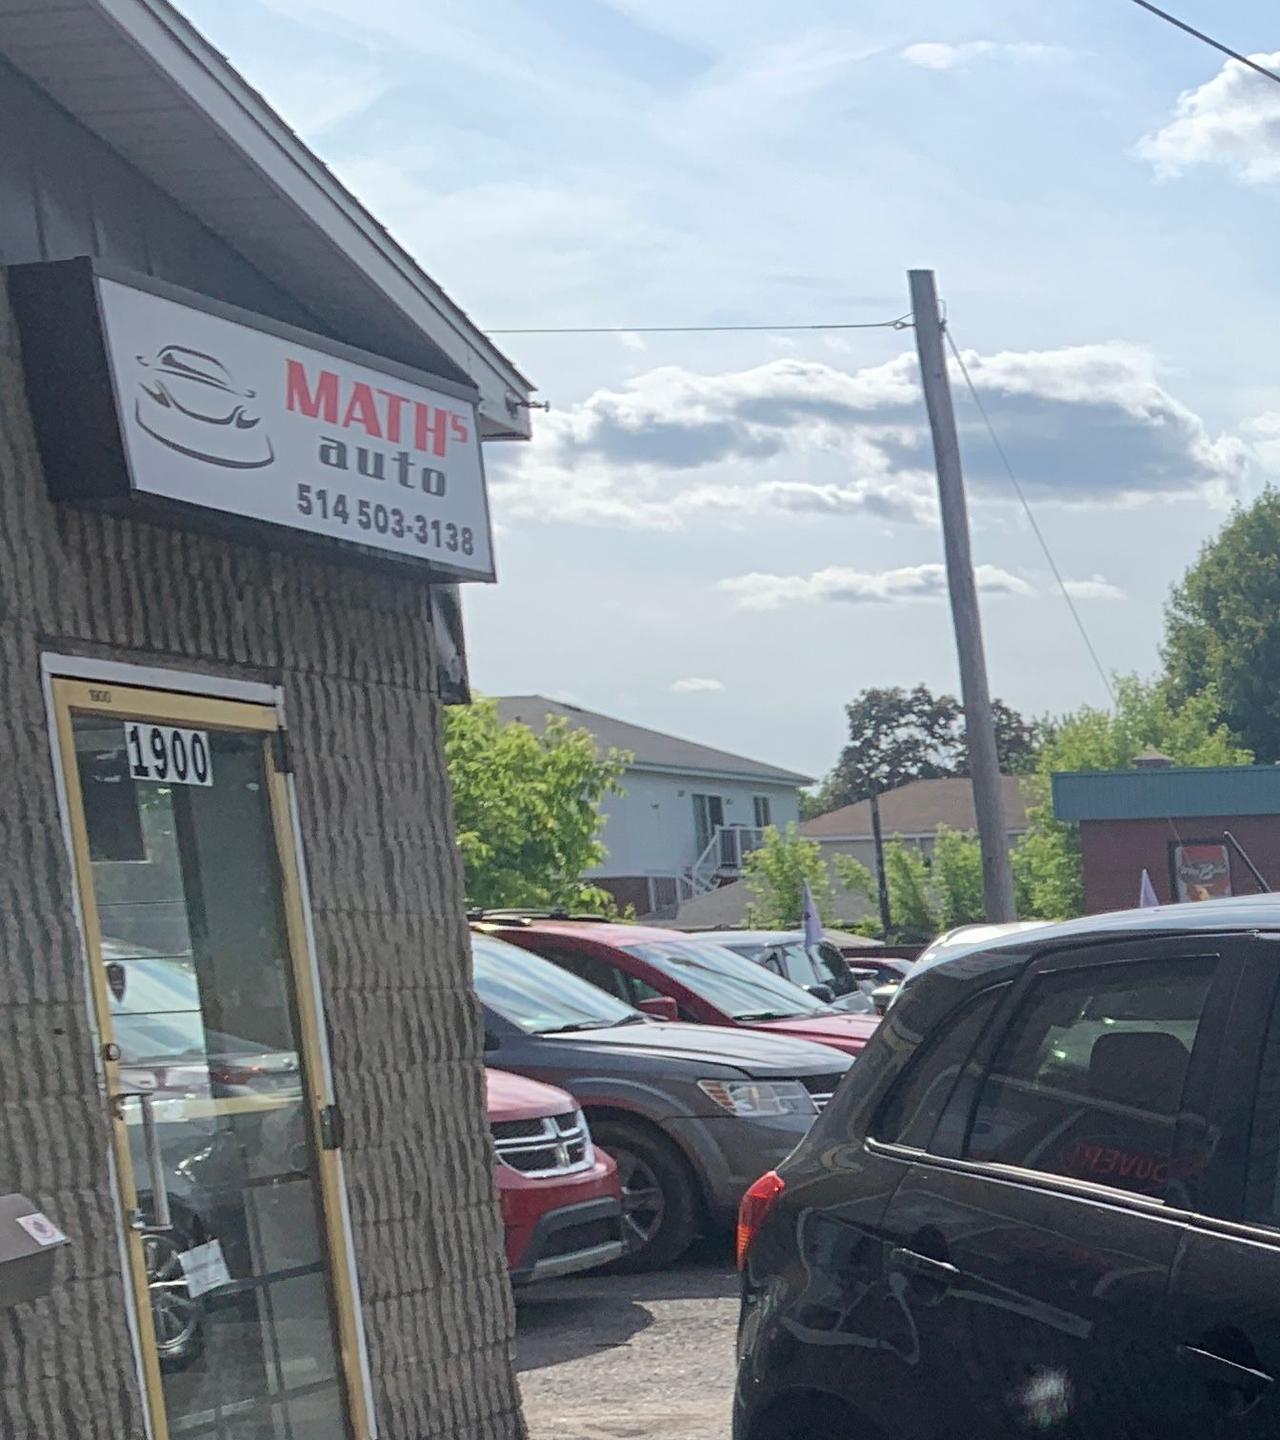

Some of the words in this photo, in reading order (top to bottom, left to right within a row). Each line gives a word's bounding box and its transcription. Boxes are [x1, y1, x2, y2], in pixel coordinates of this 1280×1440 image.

[319, 435, 446, 498] auto
[297, 482, 350, 525] 514
[357, 499, 475, 556] 503-3138
[130, 725, 208, 784] 1900
